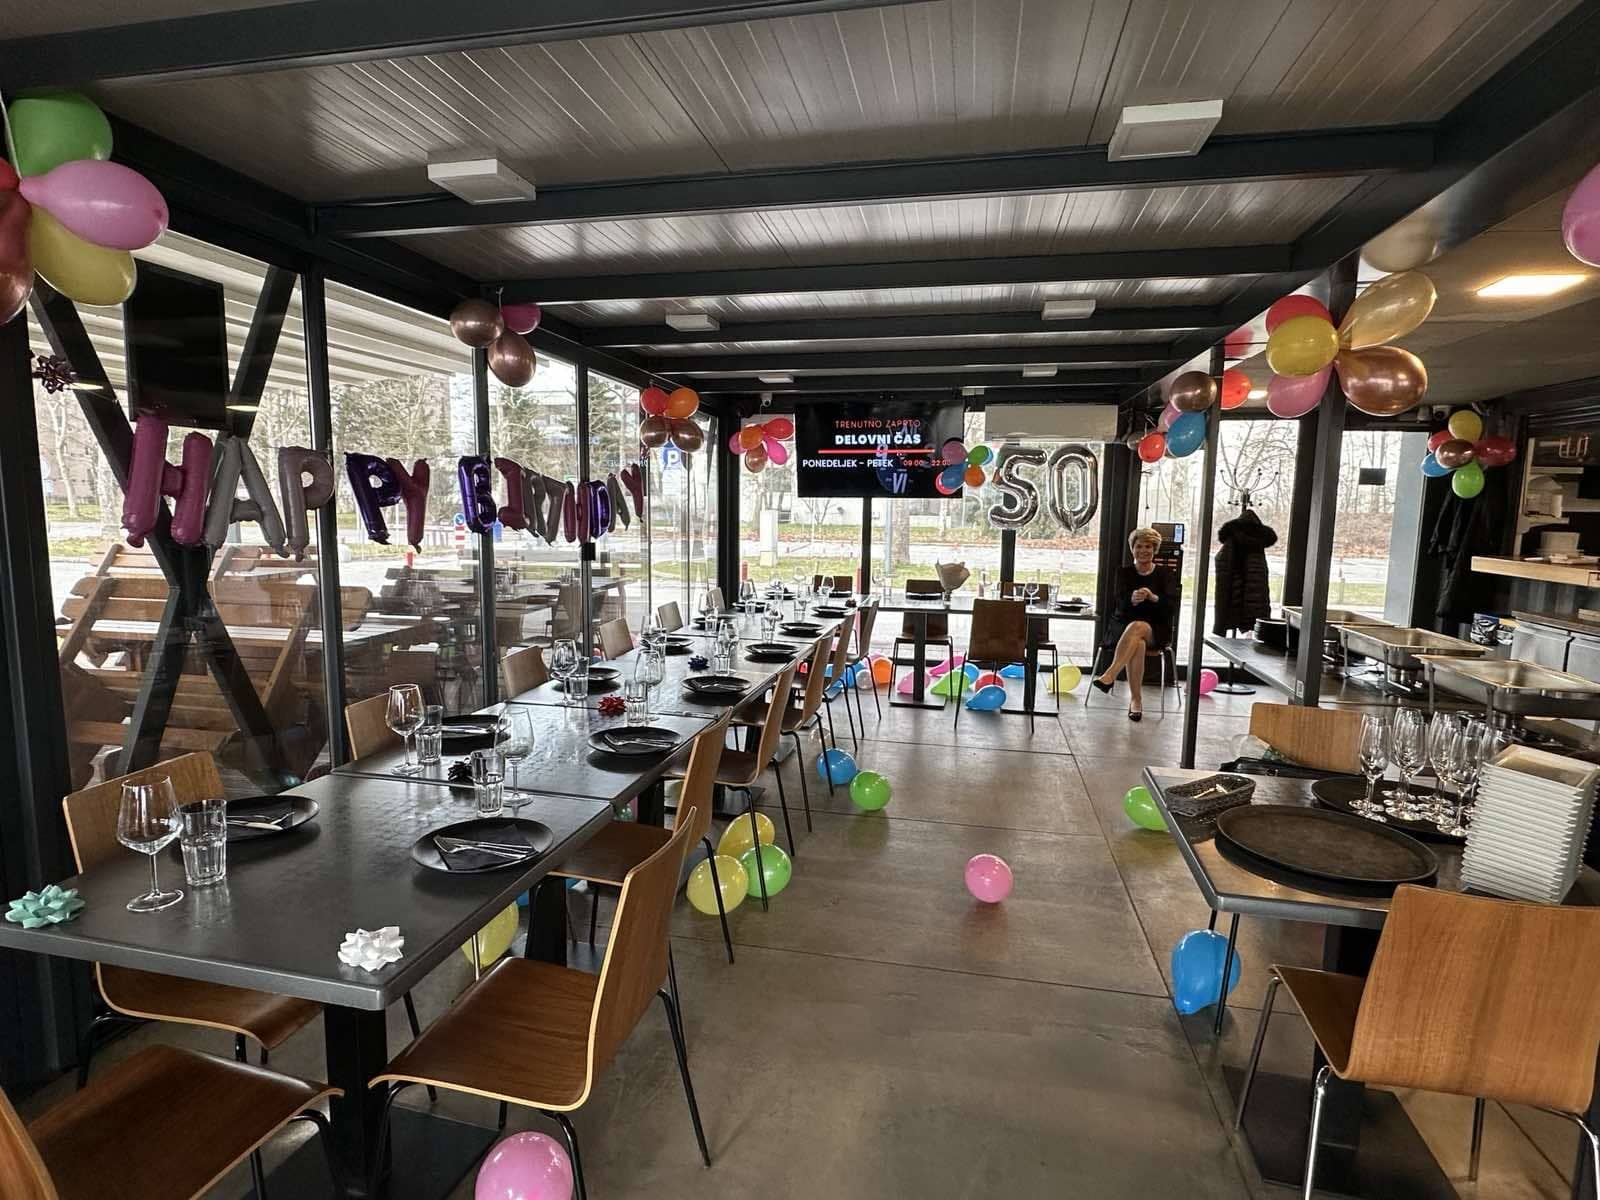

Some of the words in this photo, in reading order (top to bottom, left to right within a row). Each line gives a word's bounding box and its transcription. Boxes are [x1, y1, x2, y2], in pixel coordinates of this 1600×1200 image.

[834, 419, 882, 429] TRENUTNO
[885, 419, 921, 428] ZAPRTO
[834, 434, 891, 445] DELOVNI
[893, 432, 922, 444] ČAS
[667, 450, 681, 467] P
[801, 459, 857, 469] PONEDELJEK
[867, 459, 894, 468] PETEK
[121, 412, 431, 562] HAPPY
[987, 443, 1099, 531] 50
